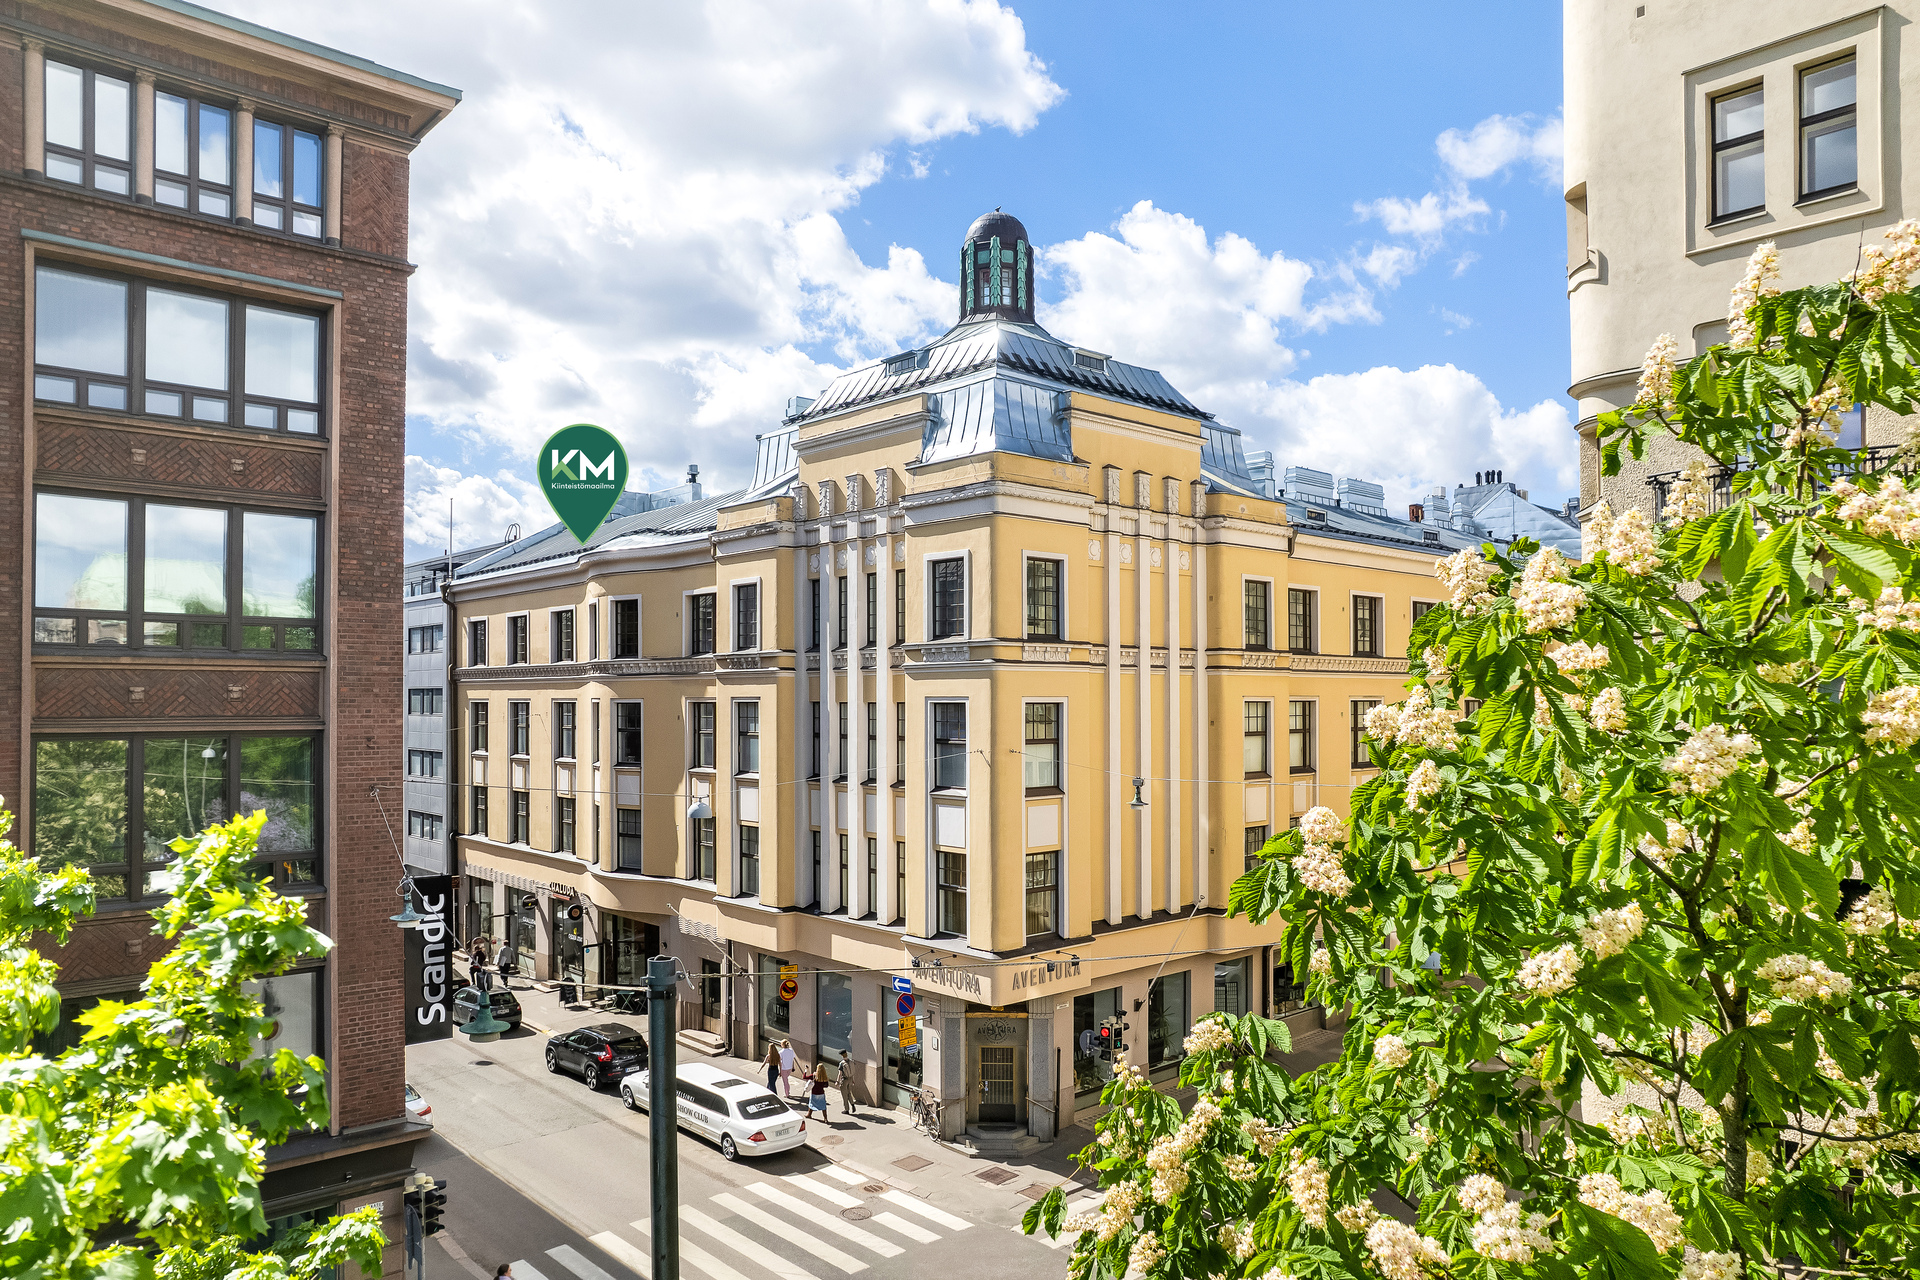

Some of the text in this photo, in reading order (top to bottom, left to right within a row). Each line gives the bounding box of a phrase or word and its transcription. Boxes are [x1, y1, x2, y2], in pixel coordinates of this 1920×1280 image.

[415, 893, 446, 1026] Scandic
[677, 1103, 709, 1123] SHOW CLUB
